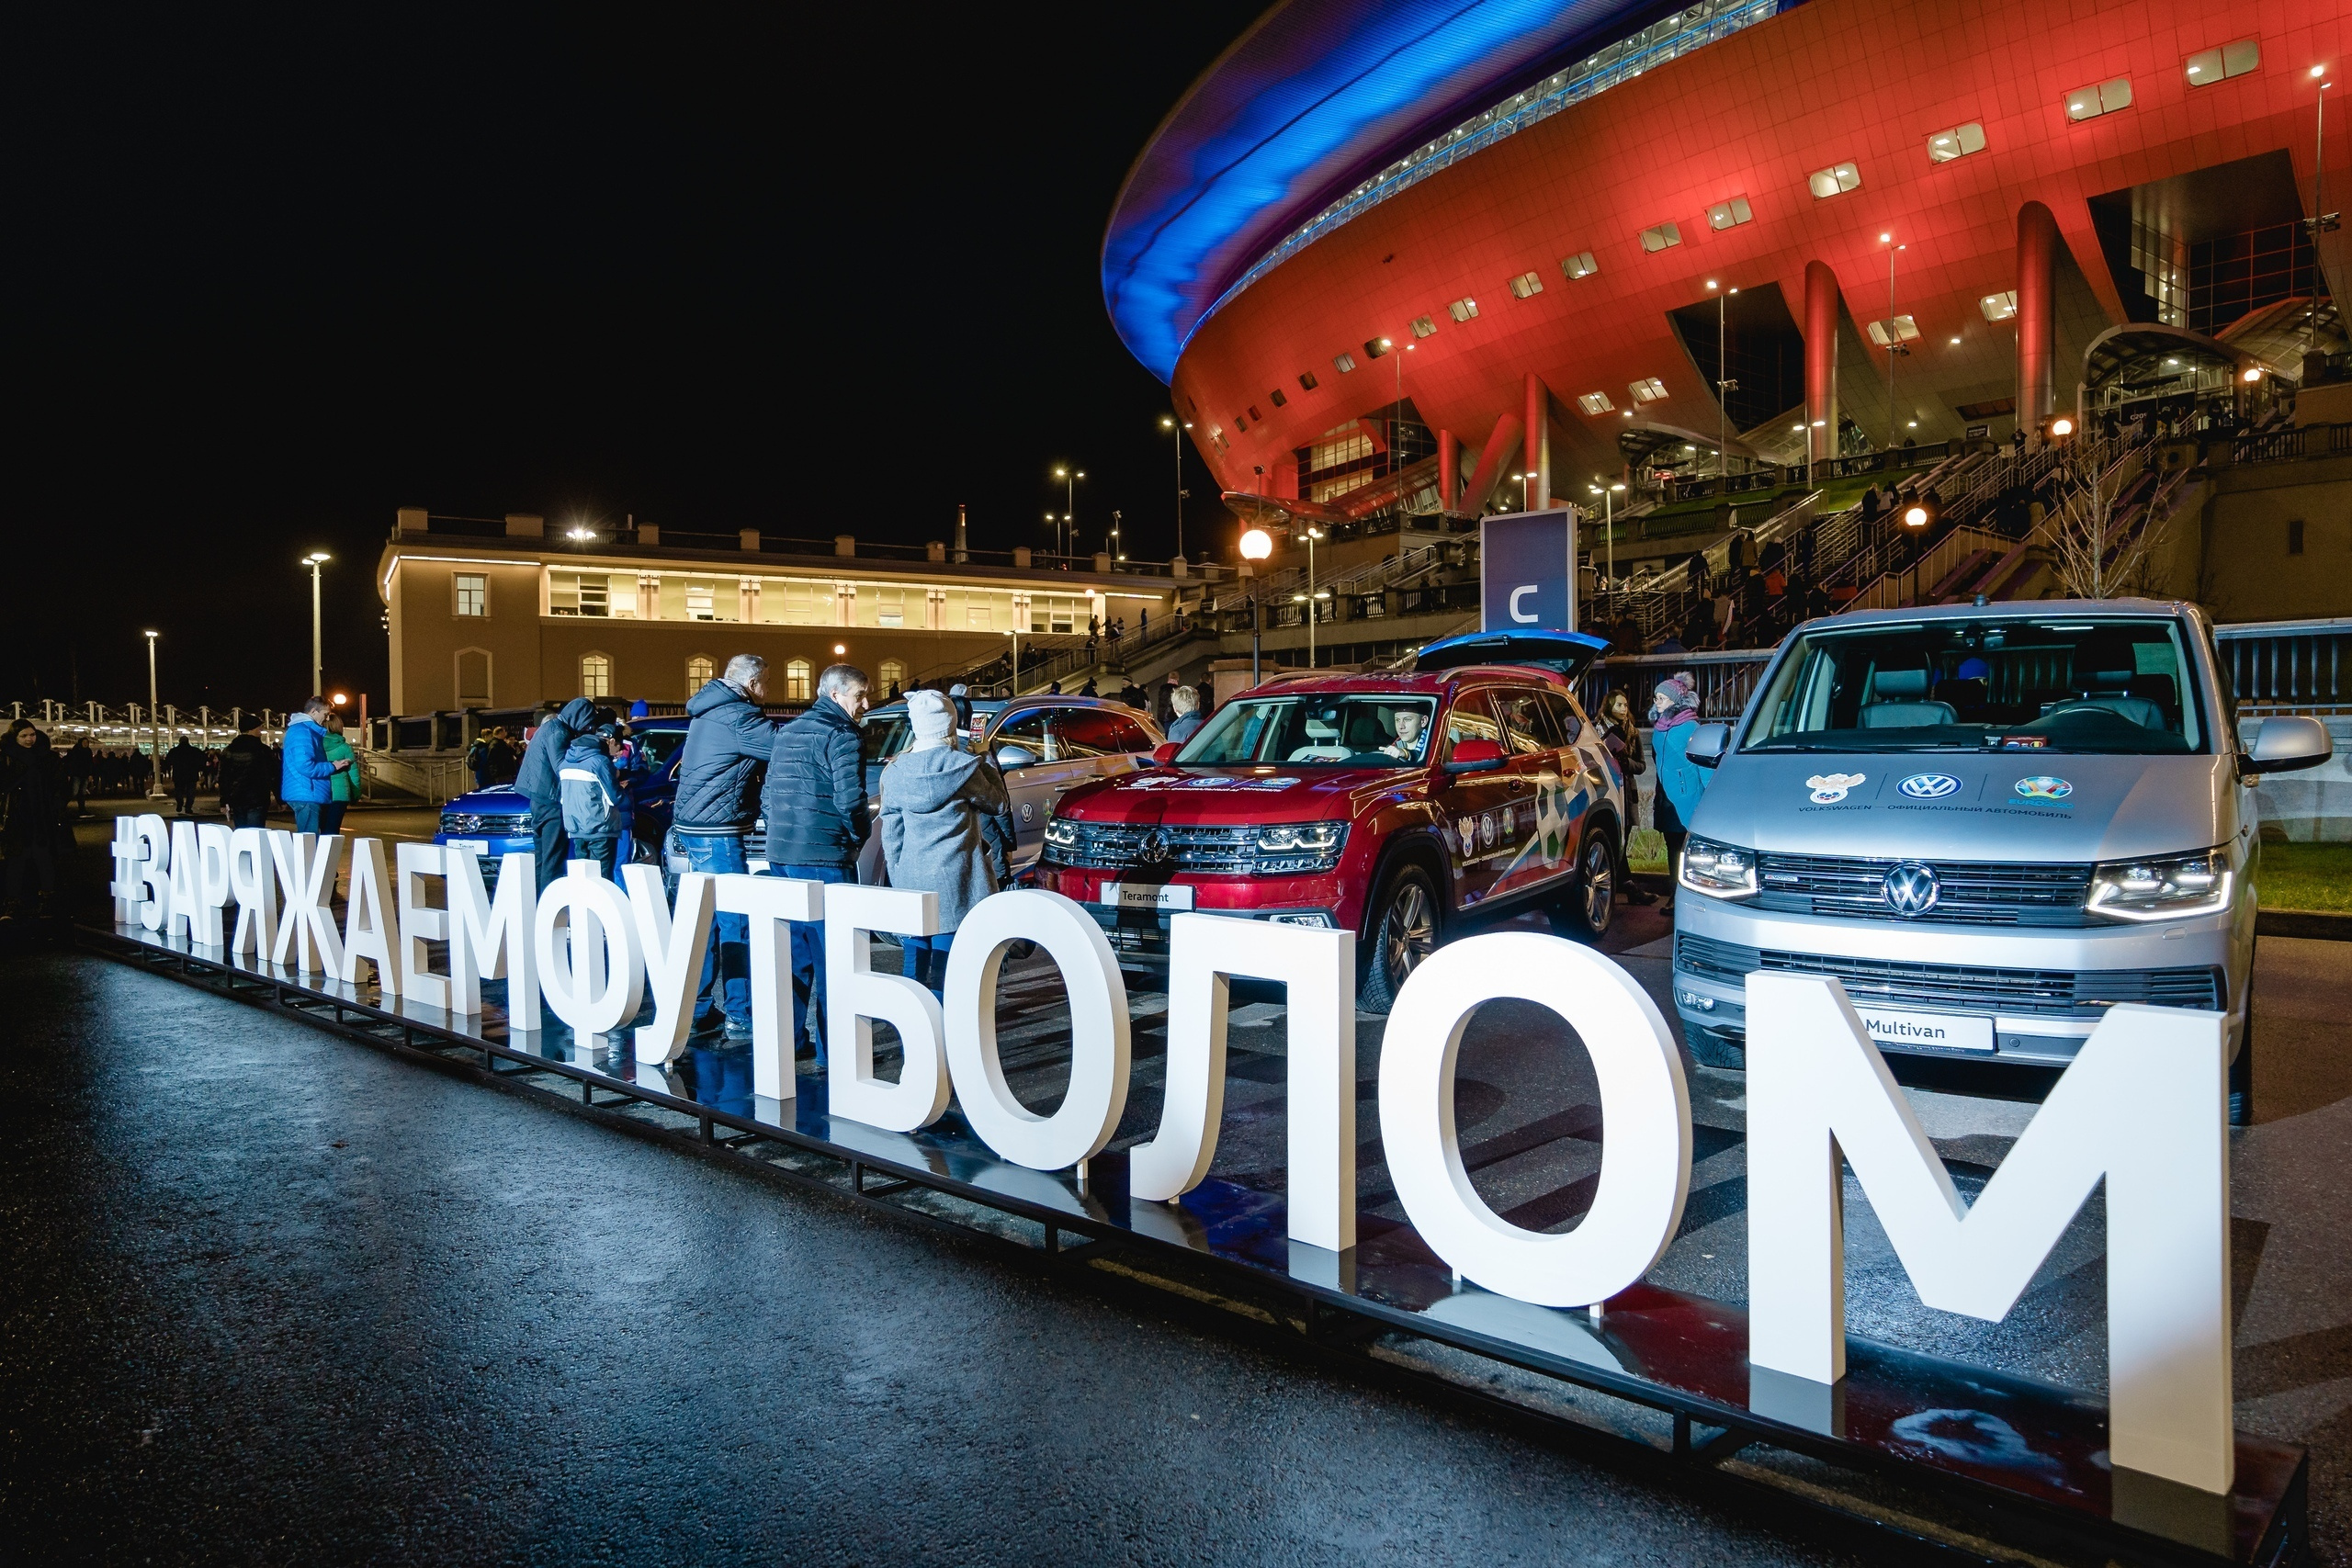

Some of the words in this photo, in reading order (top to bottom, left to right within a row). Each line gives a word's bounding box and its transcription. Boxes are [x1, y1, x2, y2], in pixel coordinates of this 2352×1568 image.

[1510, 584, 1539, 624] C
[1798, 804, 1872, 812] VOLKSWAGEN
[1887, 804, 1983, 813] ОФИЦИАЛЬНЫЙ
[1984, 807, 2073, 819] АВТОМОБИЛЬ
[1122, 890, 1170, 902] Teramont
[1866, 1019, 1946, 1039] Multivan
[111, 813, 2234, 1497] #ЗАРЯЖАЕМФУТБОЛОМ
